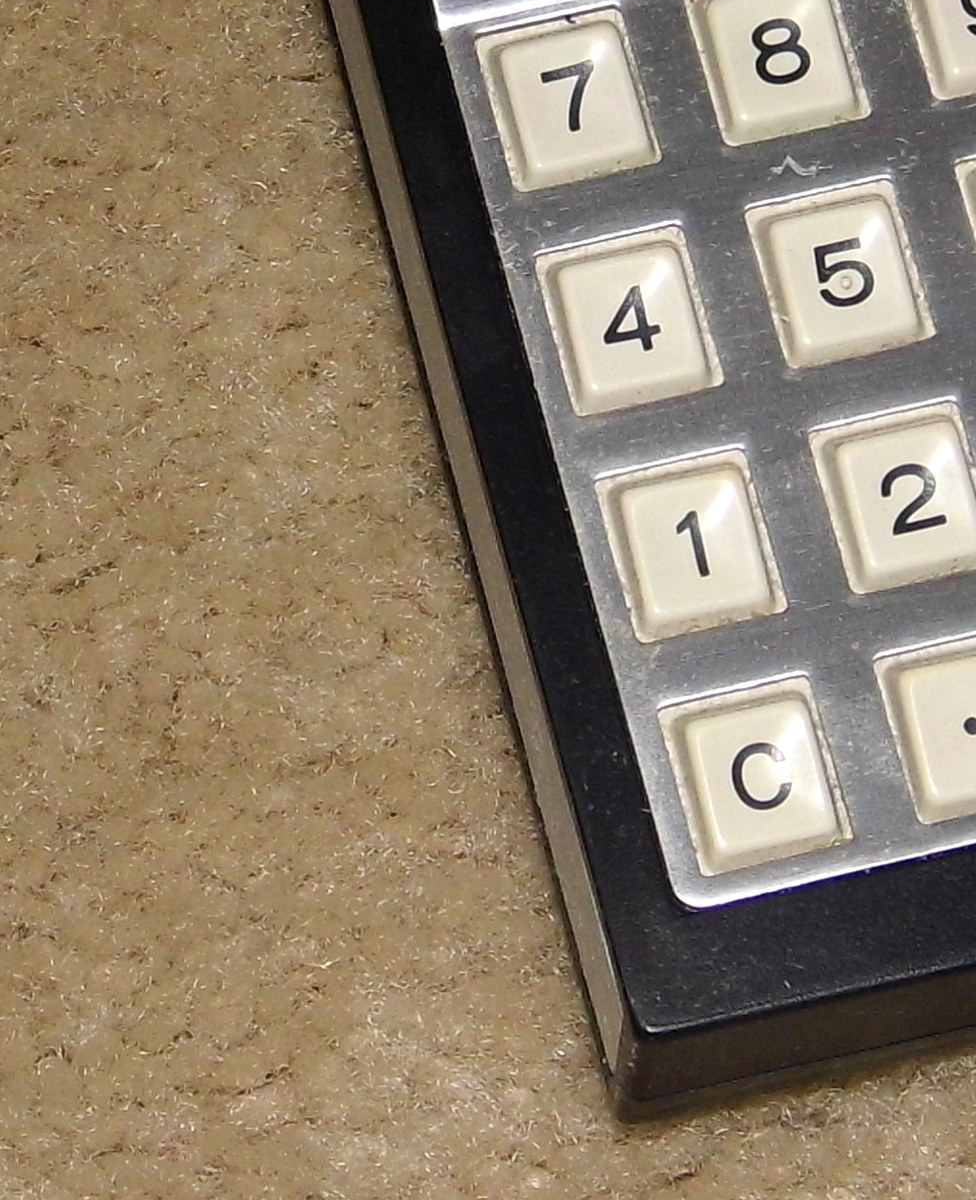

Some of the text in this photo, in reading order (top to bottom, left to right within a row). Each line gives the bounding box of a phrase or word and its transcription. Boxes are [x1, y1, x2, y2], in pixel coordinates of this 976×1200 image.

[752, 19, 811, 85] 8
[540, 60, 594, 133] 7
[814, 238, 875, 308] 5
[604, 286, 661, 352] 4
[881, 464, 947, 536] 2
[676, 511, 711, 578] 1
[732, 743, 791, 811] C
